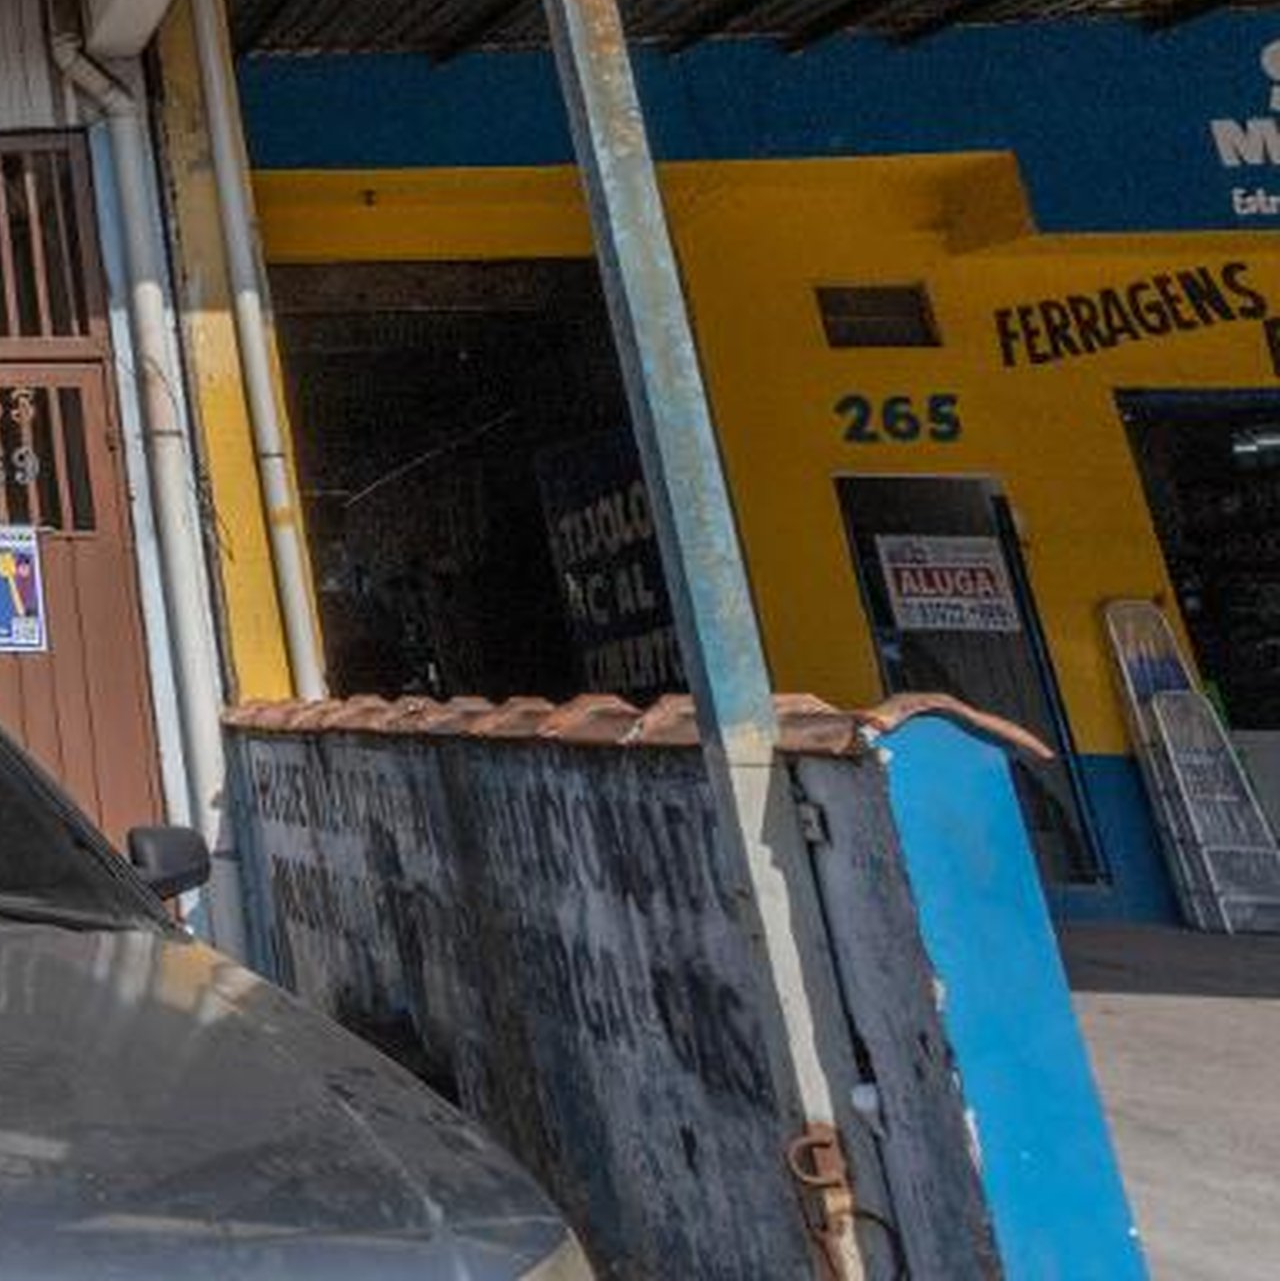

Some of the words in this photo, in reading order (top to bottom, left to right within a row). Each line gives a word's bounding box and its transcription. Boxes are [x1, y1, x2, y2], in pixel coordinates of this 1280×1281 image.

[994, 262, 1267, 367] FERRAGENS
[835, 393, 962, 443] 265
[900, 568, 996, 597] ALUGA
